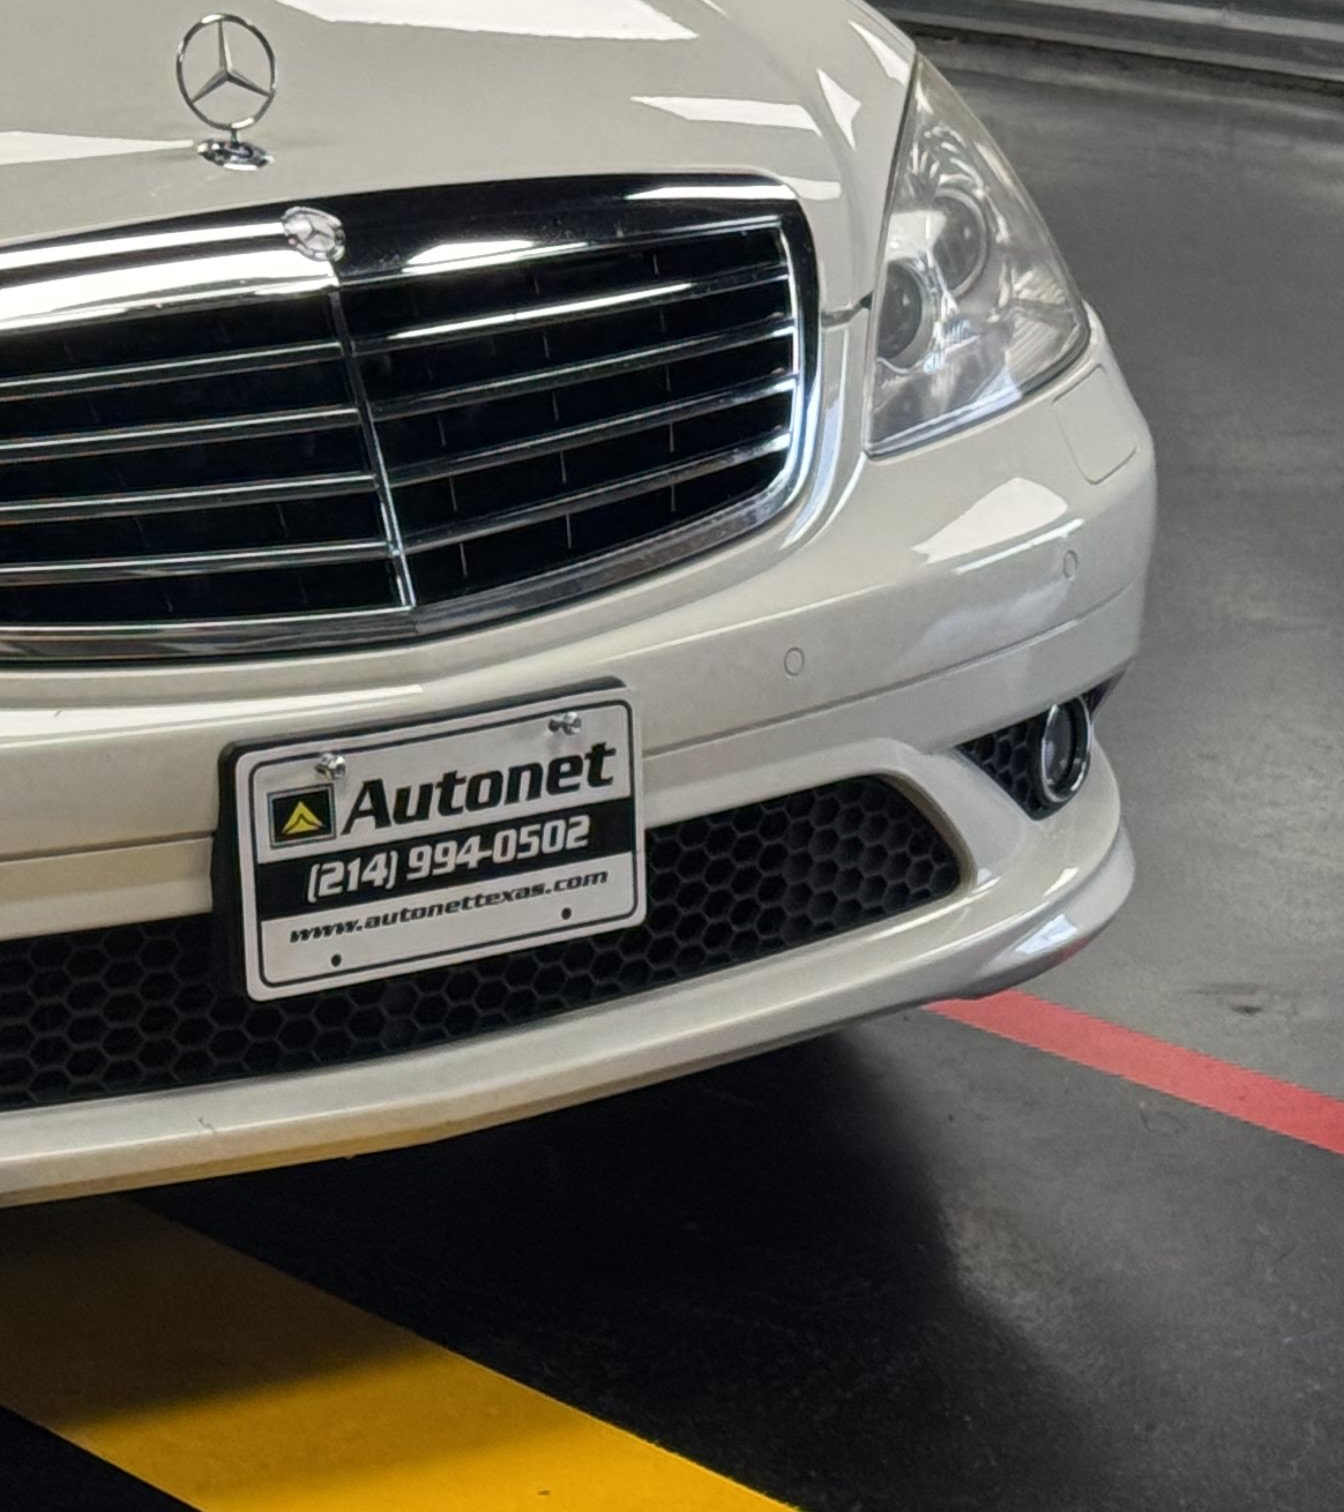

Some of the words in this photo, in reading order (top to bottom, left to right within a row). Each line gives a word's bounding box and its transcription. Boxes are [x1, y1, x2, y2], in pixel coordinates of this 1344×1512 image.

[341, 742, 616, 835] Autonet
[308, 851, 398, 904] (214)
[407, 814, 591, 881] 994-0502
[289, 870, 608, 942] www.autonettexas.com
